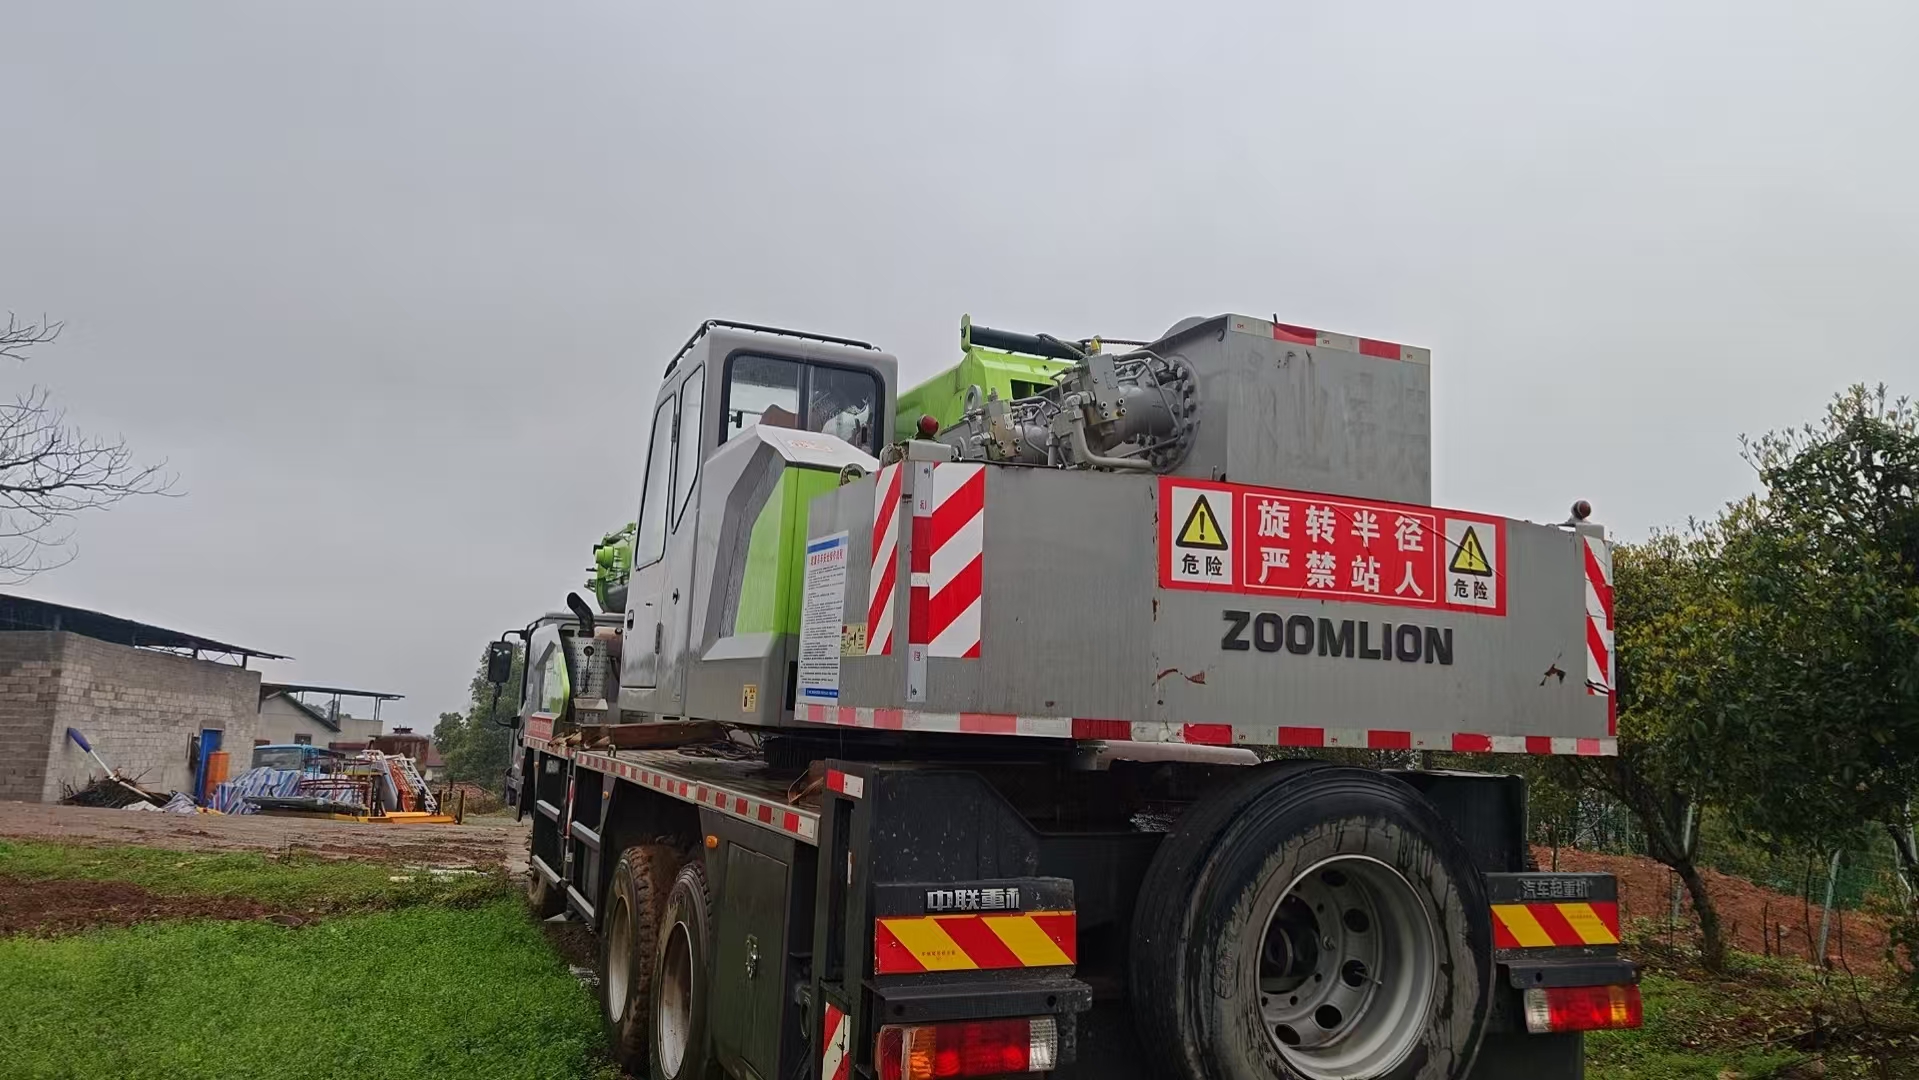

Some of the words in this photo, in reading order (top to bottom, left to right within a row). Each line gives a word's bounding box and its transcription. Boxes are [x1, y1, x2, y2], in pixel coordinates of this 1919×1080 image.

[1258, 500, 1424, 552] 旋转半径
[1182, 553, 1223, 576] 危险
[1259, 547, 1424, 597] 严禁站人
[1454, 578, 1488, 600] 危险
[1222, 610, 1454, 665] ZOOMLION
[1521, 879, 1589, 899] 汽车起重机
